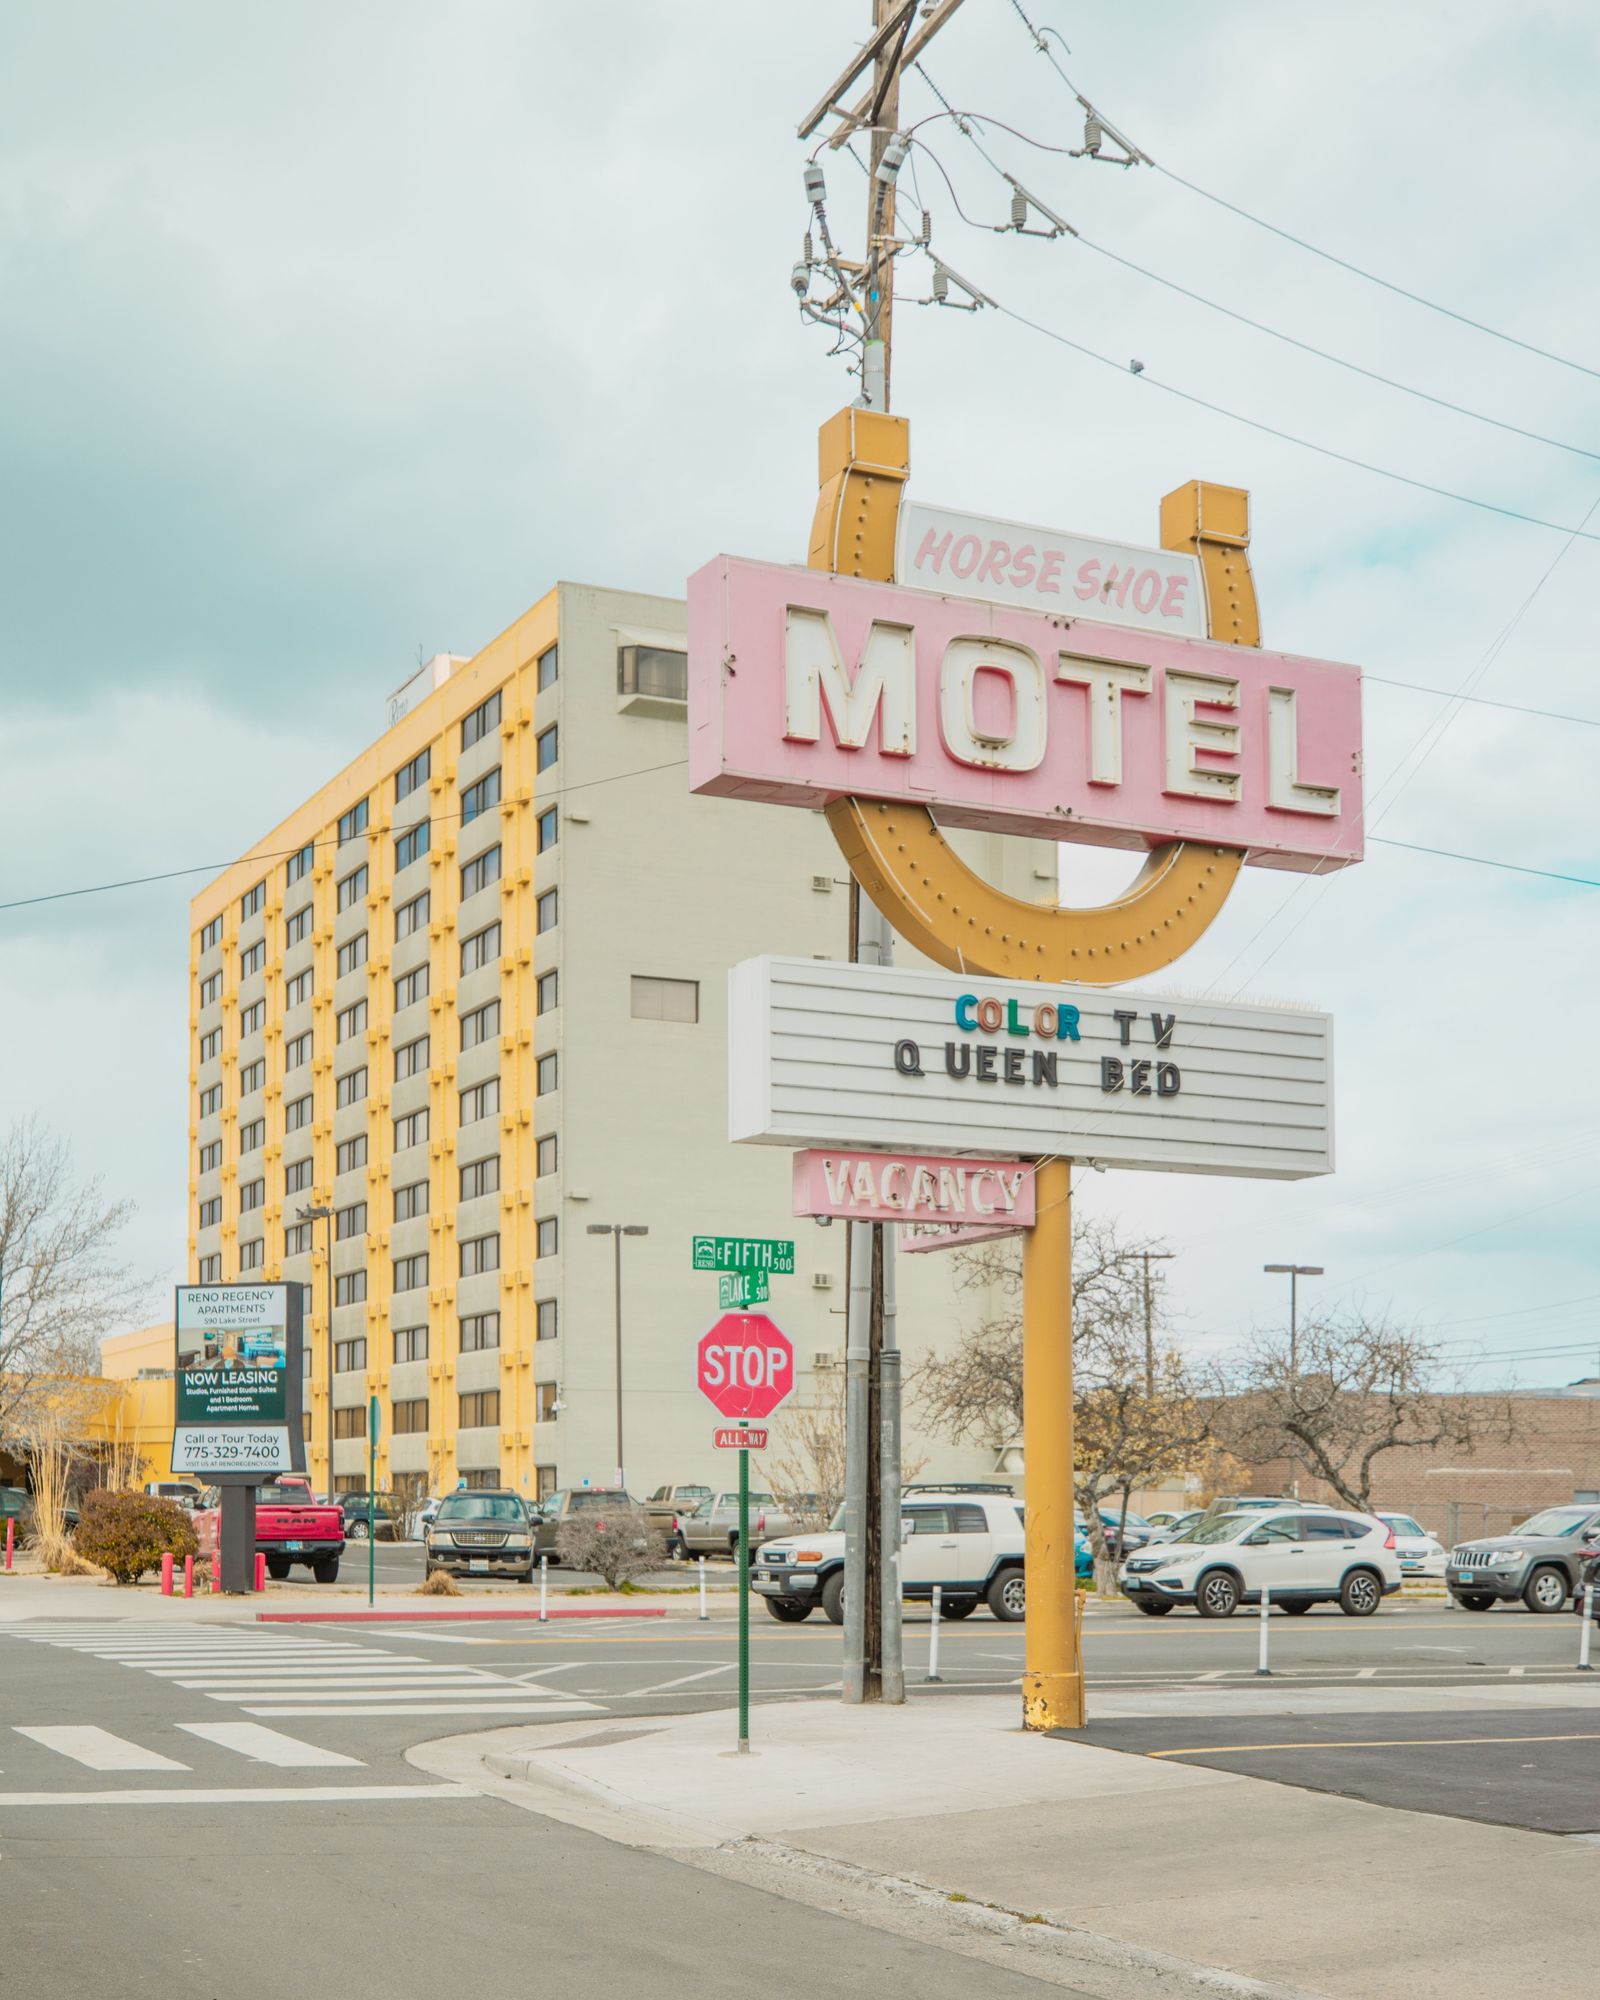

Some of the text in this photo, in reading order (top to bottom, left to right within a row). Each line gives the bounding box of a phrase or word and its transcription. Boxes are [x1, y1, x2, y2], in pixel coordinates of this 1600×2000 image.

[913, 527, 1189, 618] HORSE SHOE
[782, 603, 1341, 817] MOTEL
[955, 993, 1081, 1041] COLOR
[1100, 1055, 1181, 1097] BED
[822, 1157, 1025, 1216] VACANCY
[717, 1241, 788, 1267] E FIFTH ST
[773, 1257, 792, 1271] 500
[729, 1276, 751, 1302] LAKE
[188, 1291, 274, 1303] RENO REGENCY
[197, 1304, 266, 1315] APARTMENTS
[238, 1316, 260, 1324] Street
[703, 1344, 788, 1386] STOP
[185, 1371, 278, 1386] NOW LEASING
[210, 1387, 238, 1395] Furnished
[239, 1386, 257, 1394] Studio
[207, 1405, 238, 1413] Apartment
[185, 1434, 205, 1443] Call
[221, 1434, 244, 1443] Tour
[248, 1433, 279, 1445] Today
[720, 1433, 764, 1446] ALL WAY
[184, 1446, 280, 1459] 775-329-7400
